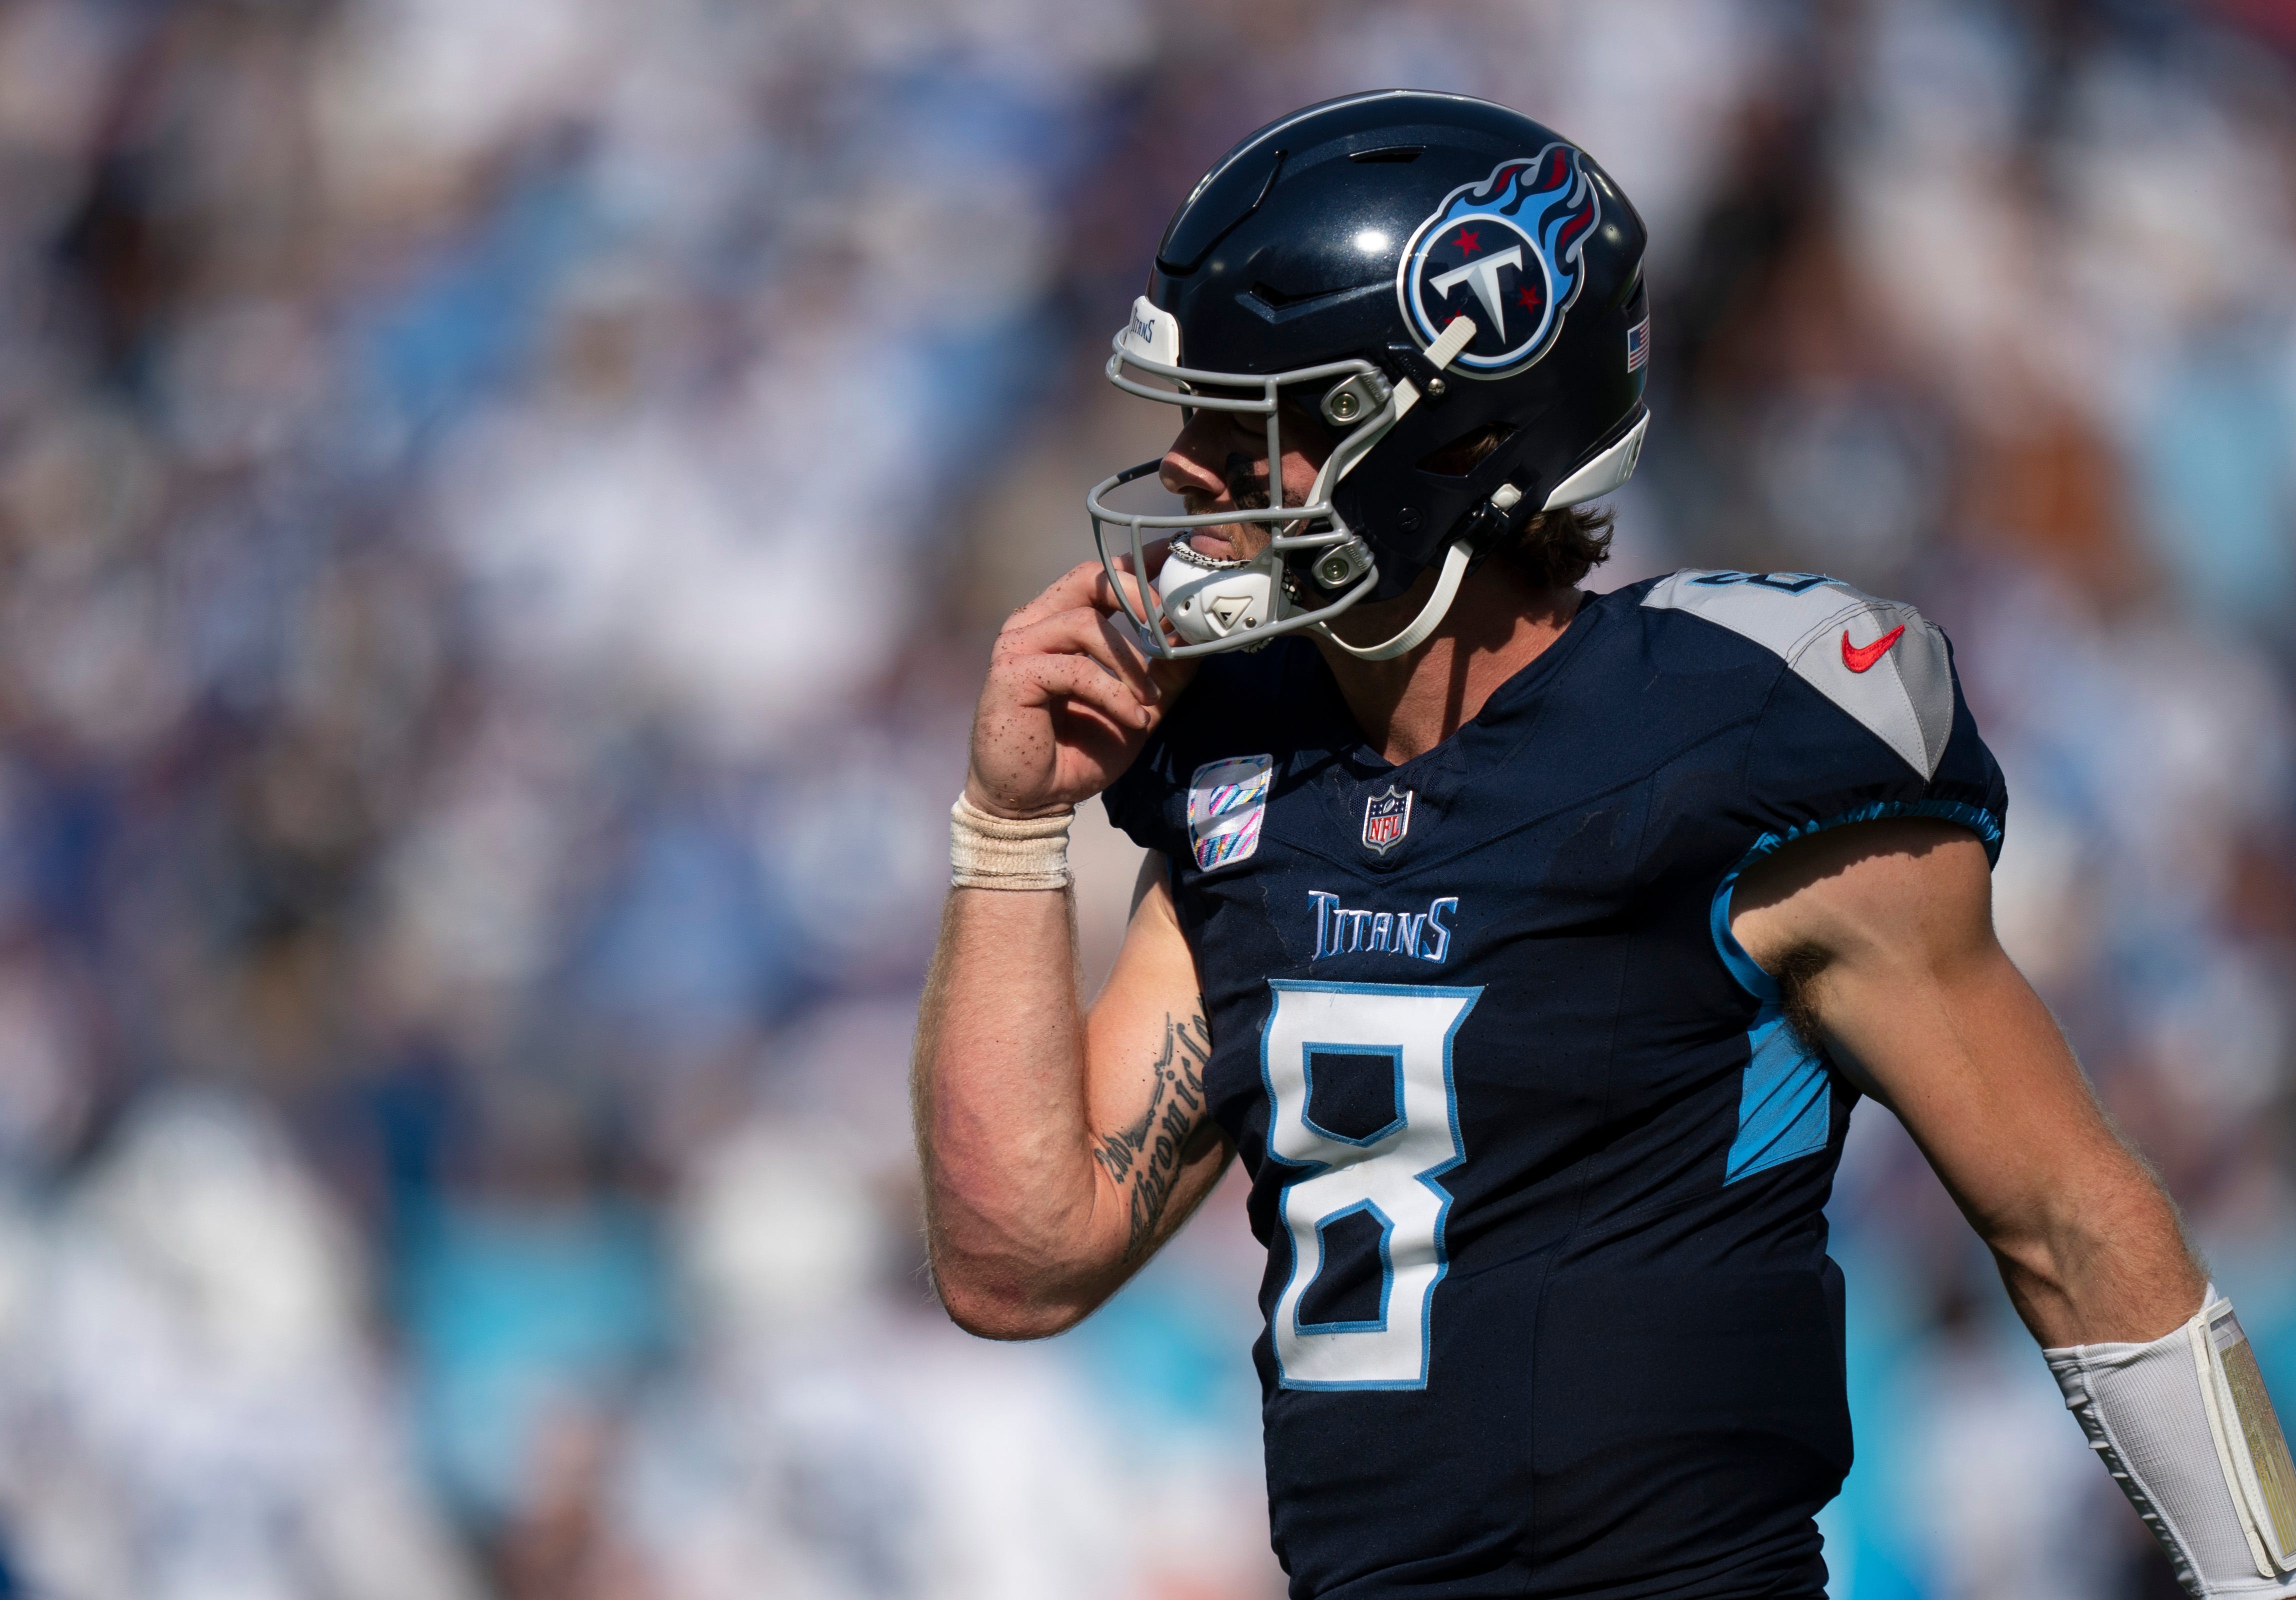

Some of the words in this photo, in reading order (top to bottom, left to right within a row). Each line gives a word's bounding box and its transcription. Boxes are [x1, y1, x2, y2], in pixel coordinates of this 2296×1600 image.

[1368, 815, 1400, 843] NFL
[1307, 890, 1459, 964] TITANS
[1260, 978, 1485, 1391] 8
